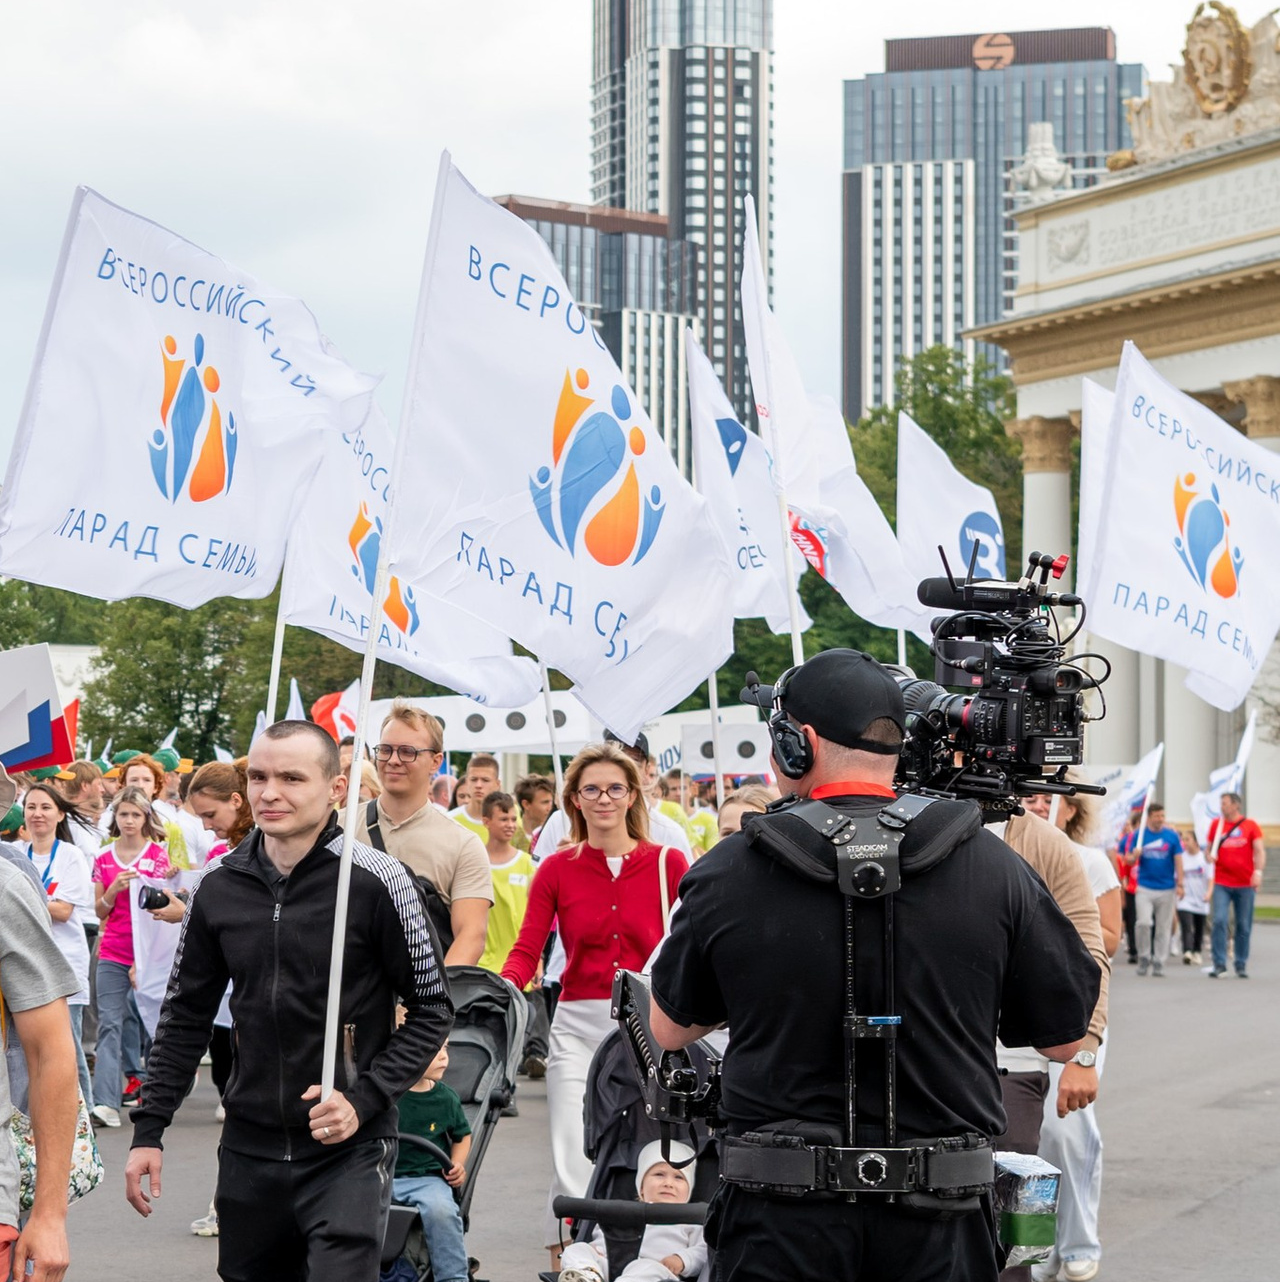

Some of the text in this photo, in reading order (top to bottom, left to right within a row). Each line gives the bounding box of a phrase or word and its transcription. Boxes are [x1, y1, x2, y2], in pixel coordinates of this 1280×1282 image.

[1132, 394, 1280, 505] ВСЕРОСИЙСК
[1113, 582, 1209, 639] ПАРАД
[846, 843, 888, 853] STEADICAM
